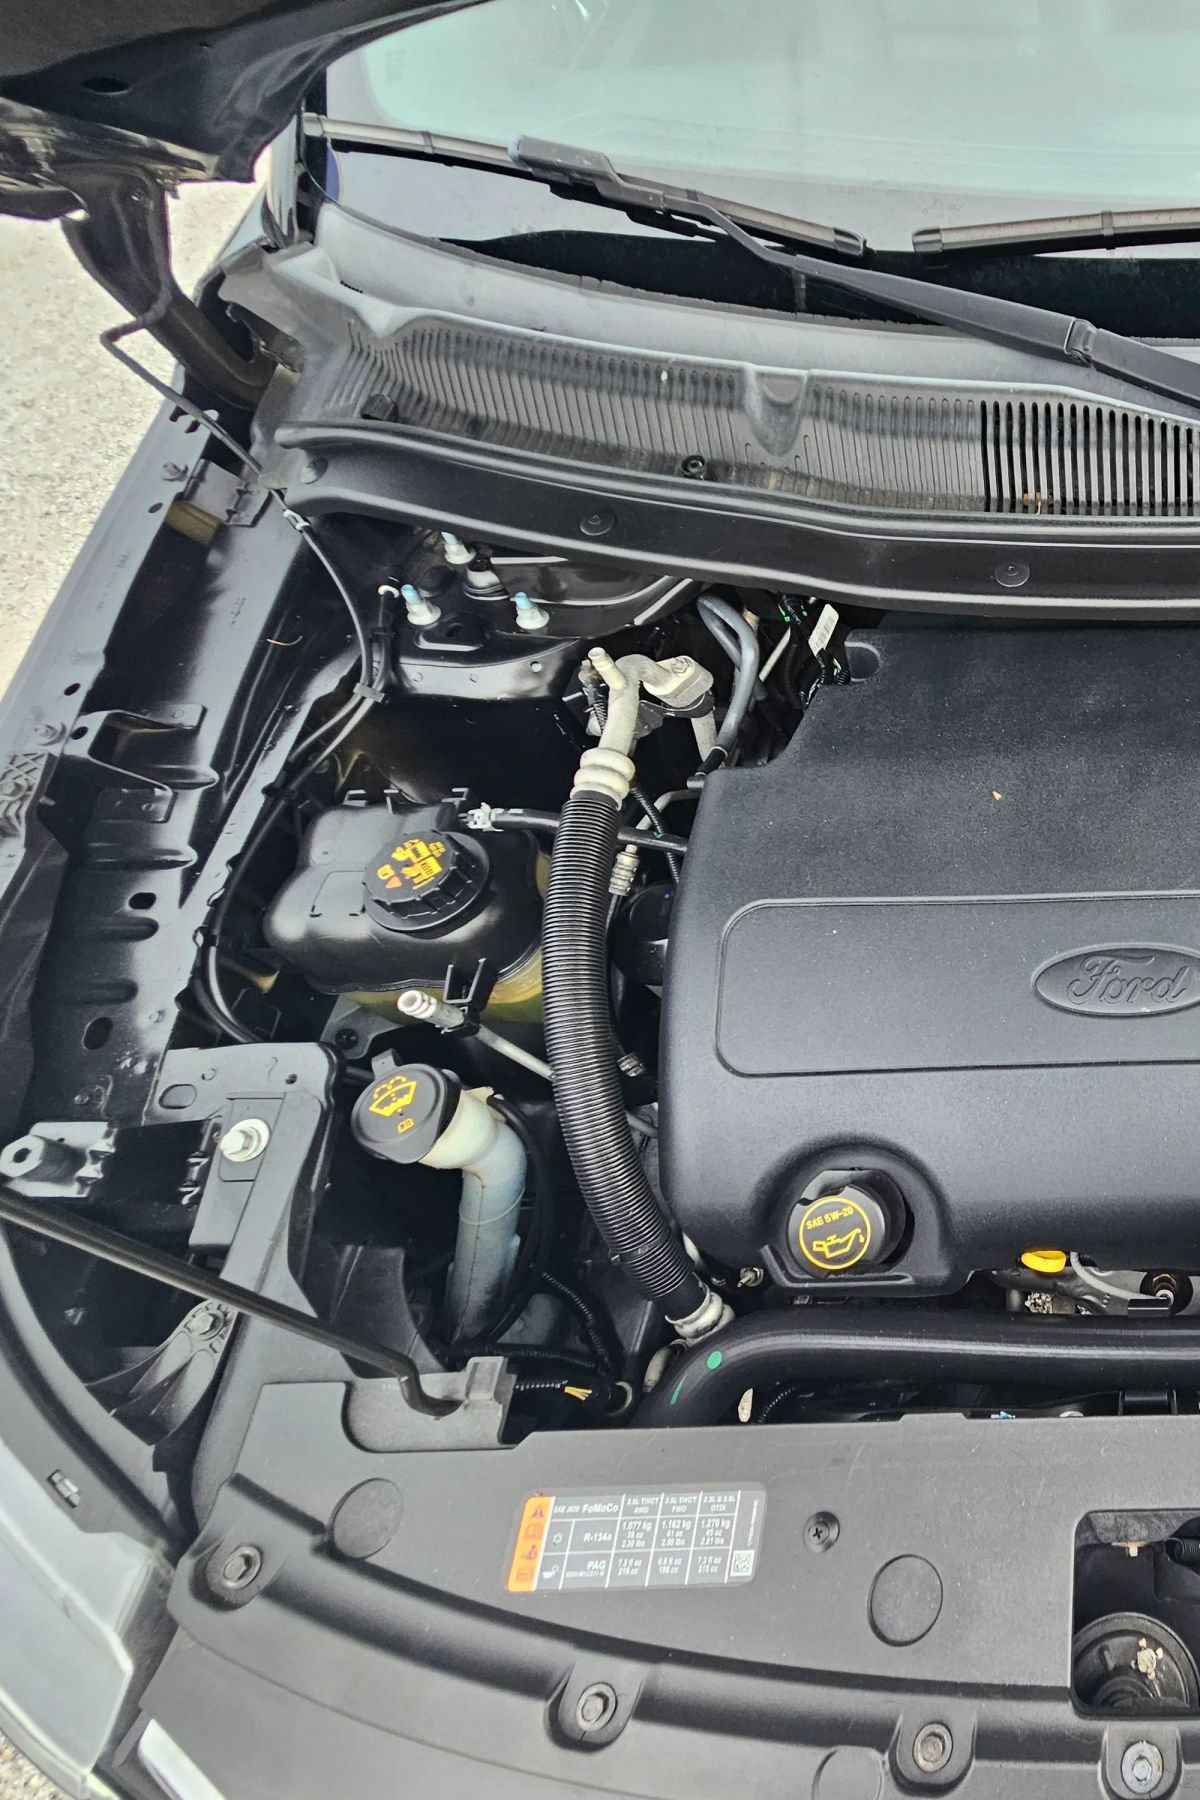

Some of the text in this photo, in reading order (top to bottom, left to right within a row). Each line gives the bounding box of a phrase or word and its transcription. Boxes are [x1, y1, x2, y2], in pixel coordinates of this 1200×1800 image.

[1066, 954, 1190, 1005] Ford
[805, 1206, 854, 1230] SAE 5W-20
[582, 1503, 619, 1513] FoMoCo
[622, 1520, 652, 1532] 1.077 kg
[662, 1519, 692, 1530] 1.162 kg
[701, 1518, 731, 1529] 1.276 kg
[583, 1532, 612, 1542] R-134a
[587, 1560, 607, 1570] PAG
